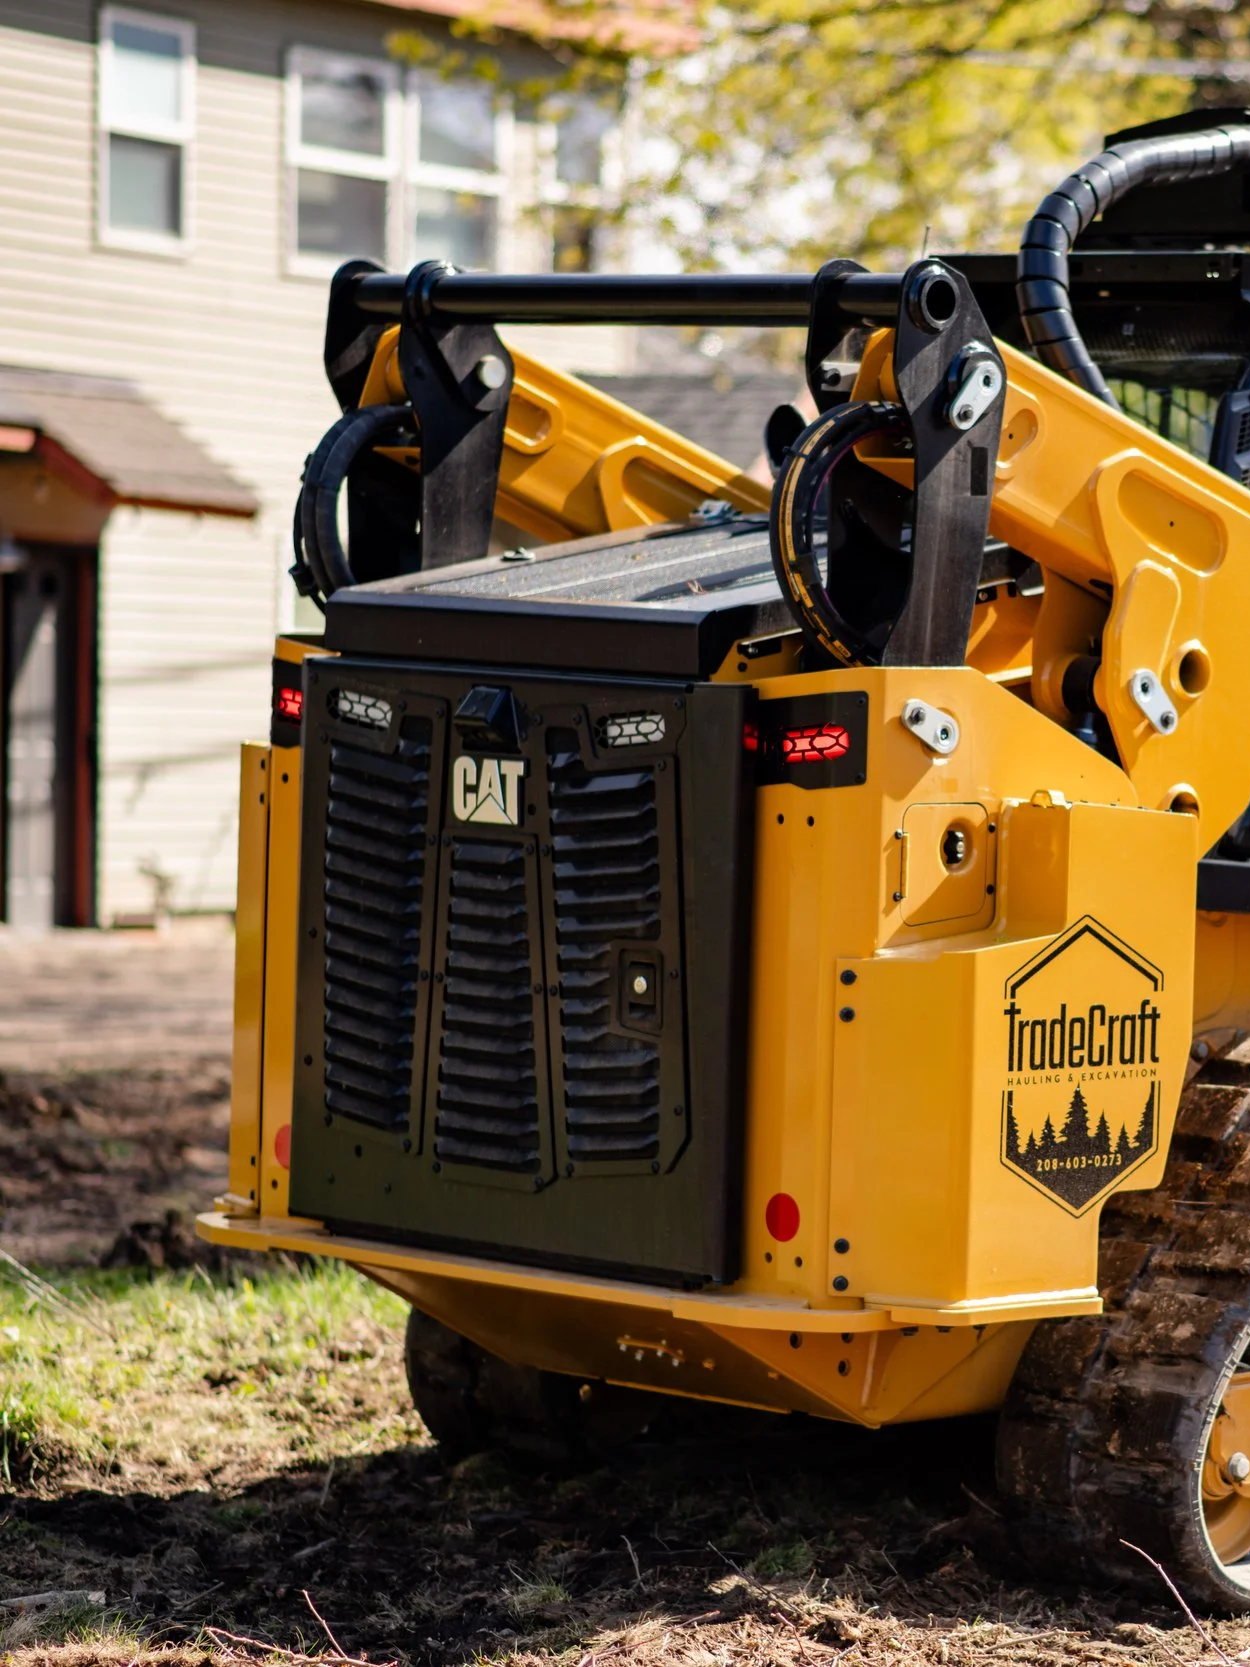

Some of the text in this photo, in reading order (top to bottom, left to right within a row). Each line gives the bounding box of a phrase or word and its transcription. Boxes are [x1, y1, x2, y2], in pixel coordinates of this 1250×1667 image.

[453, 756, 524, 825] CAT
[1007, 1068, 1157, 1086] HAULING & EXCAVATION
[1036, 1153, 1122, 1172] 208-603-0273
